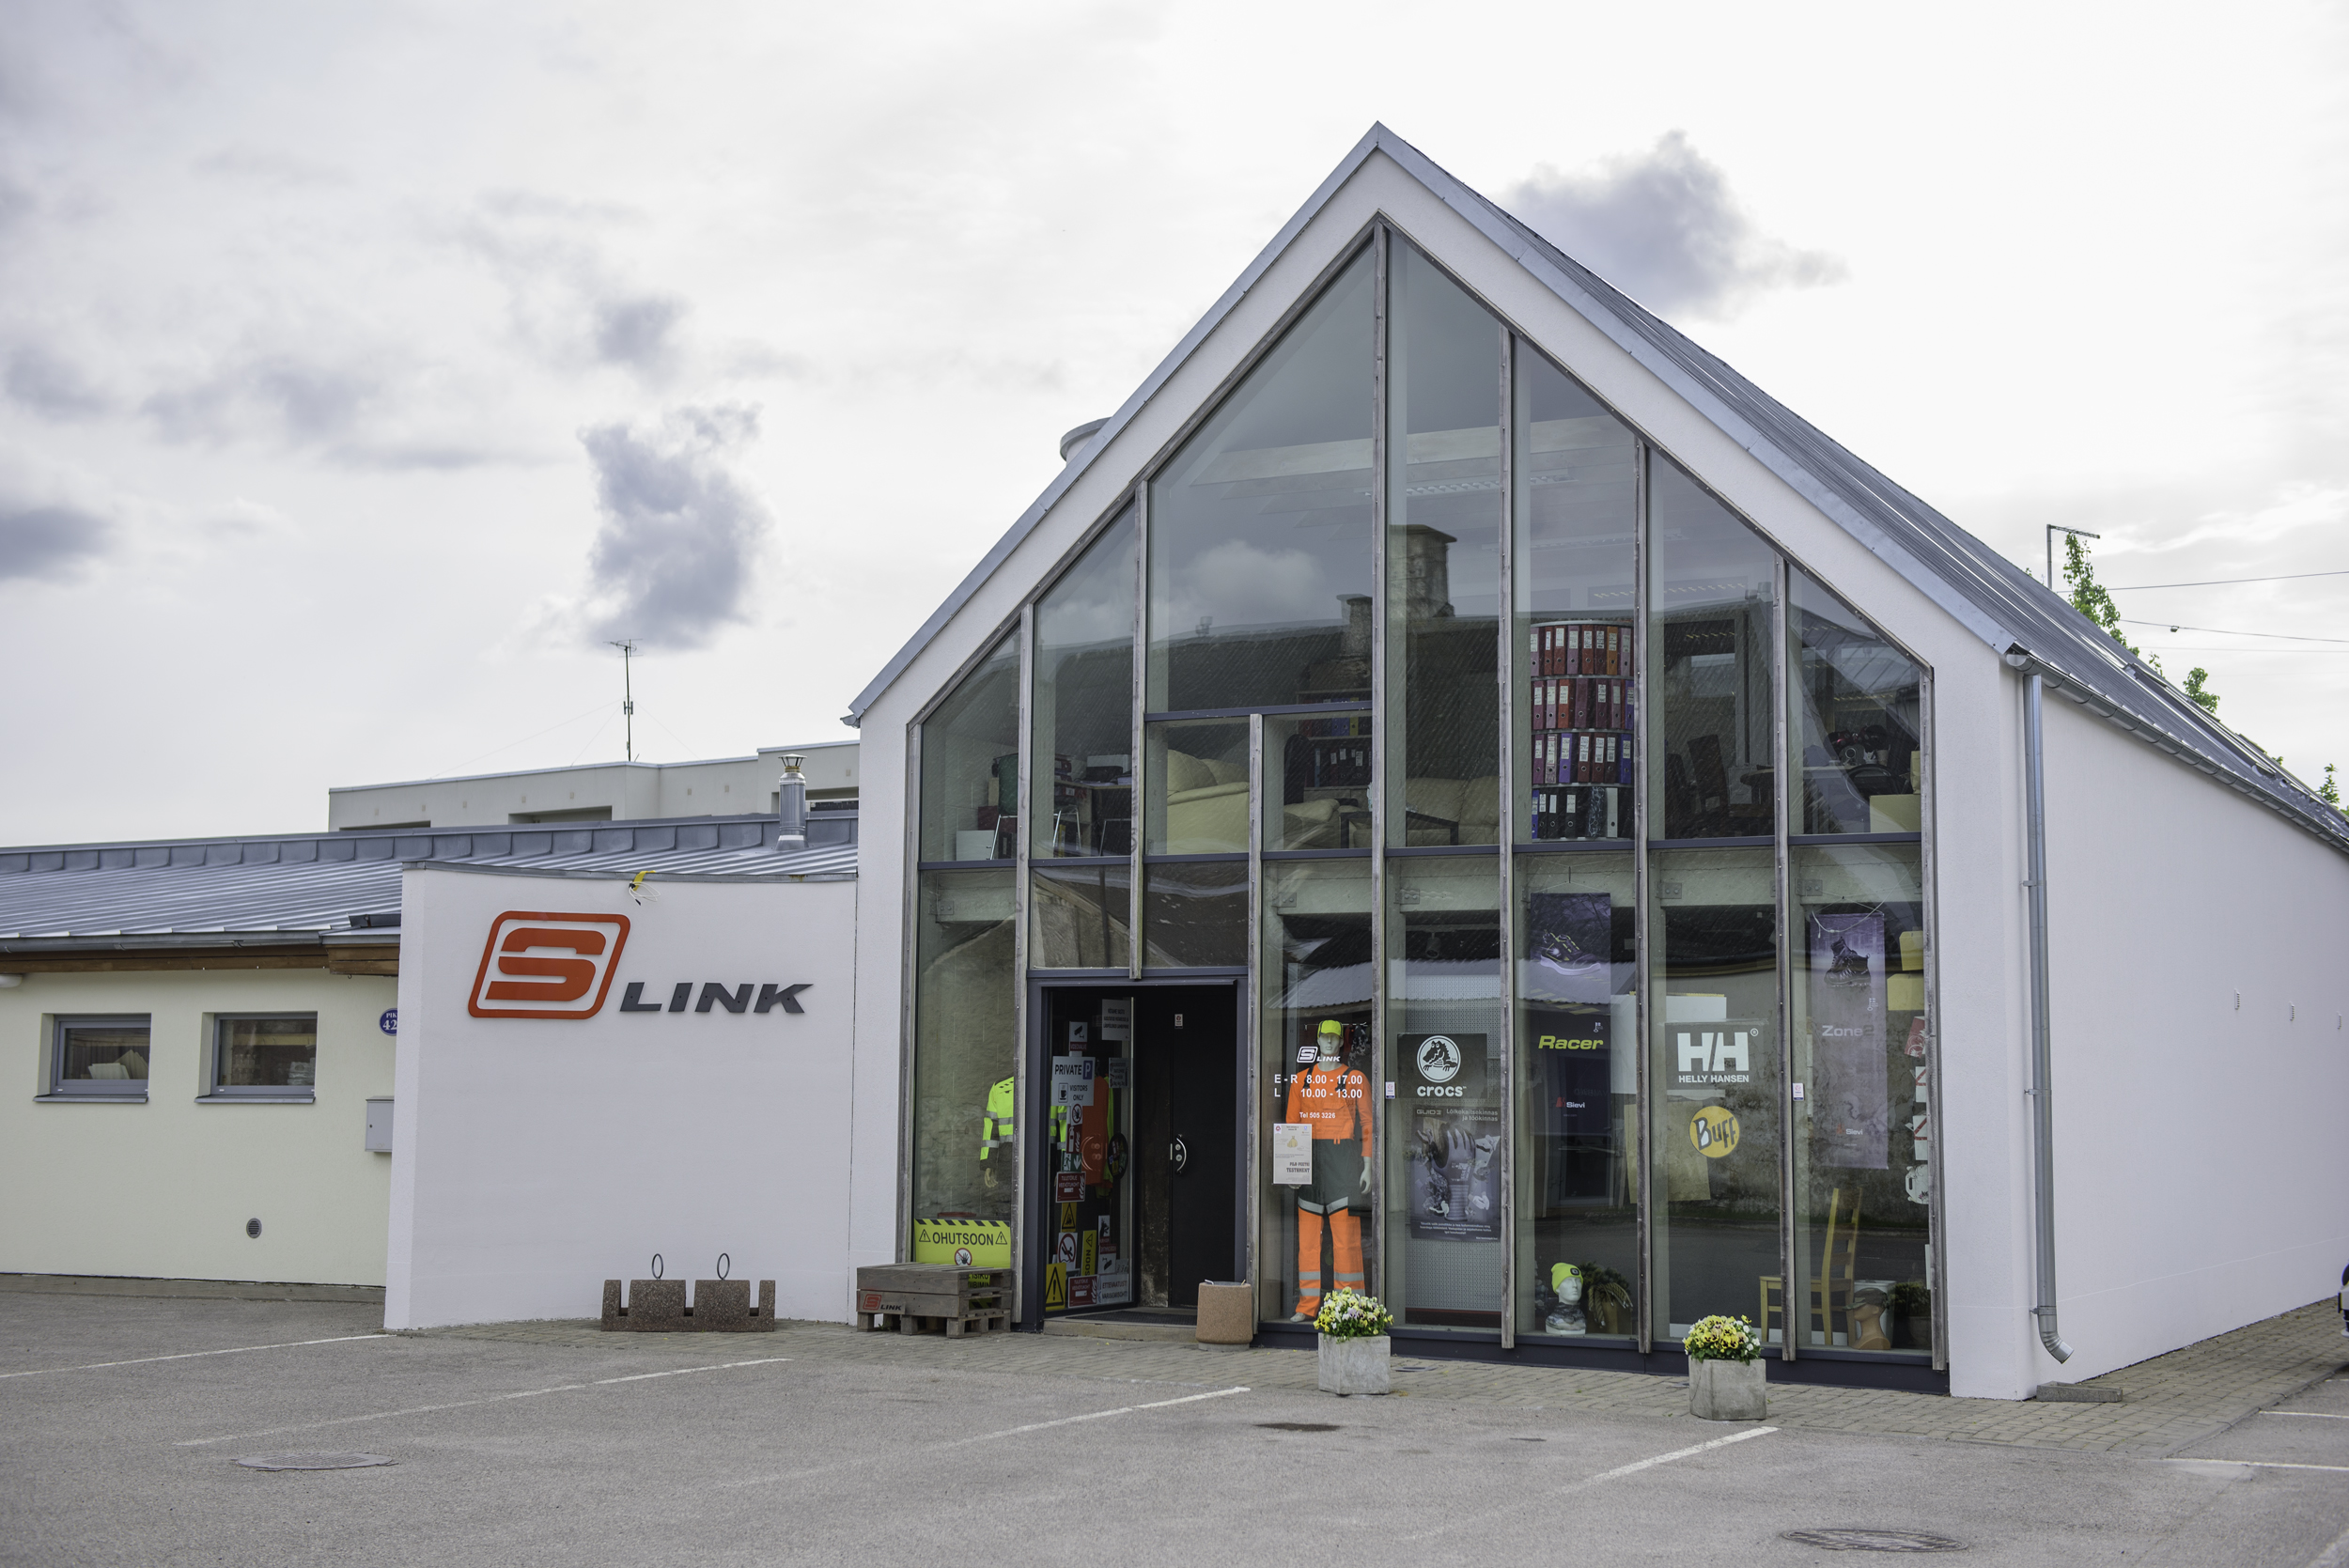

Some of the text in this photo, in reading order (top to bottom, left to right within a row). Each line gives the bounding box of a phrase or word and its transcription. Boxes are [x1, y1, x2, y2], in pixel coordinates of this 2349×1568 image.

[619, 981, 814, 1014] LINK
[383, 1019, 397, 1031] 42
[1538, 1035, 1604, 1050] Racer
[1054, 1064, 1081, 1076] PRIVATE
[1274, 1074, 1282, 1084] E
[1290, 1074, 1299, 1084] R
[1306, 1075, 1327, 1084] 8.00
[1336, 1075, 1362, 1085] 17.00
[1678, 1075, 1750, 1083] HELLY HANSEN
[1274, 1087, 1281, 1097] L
[1300, 1088, 1327, 1097] 10.00
[1336, 1089, 1362, 1098] 13.00
[932, 1232, 994, 1246] OHUTSOON
